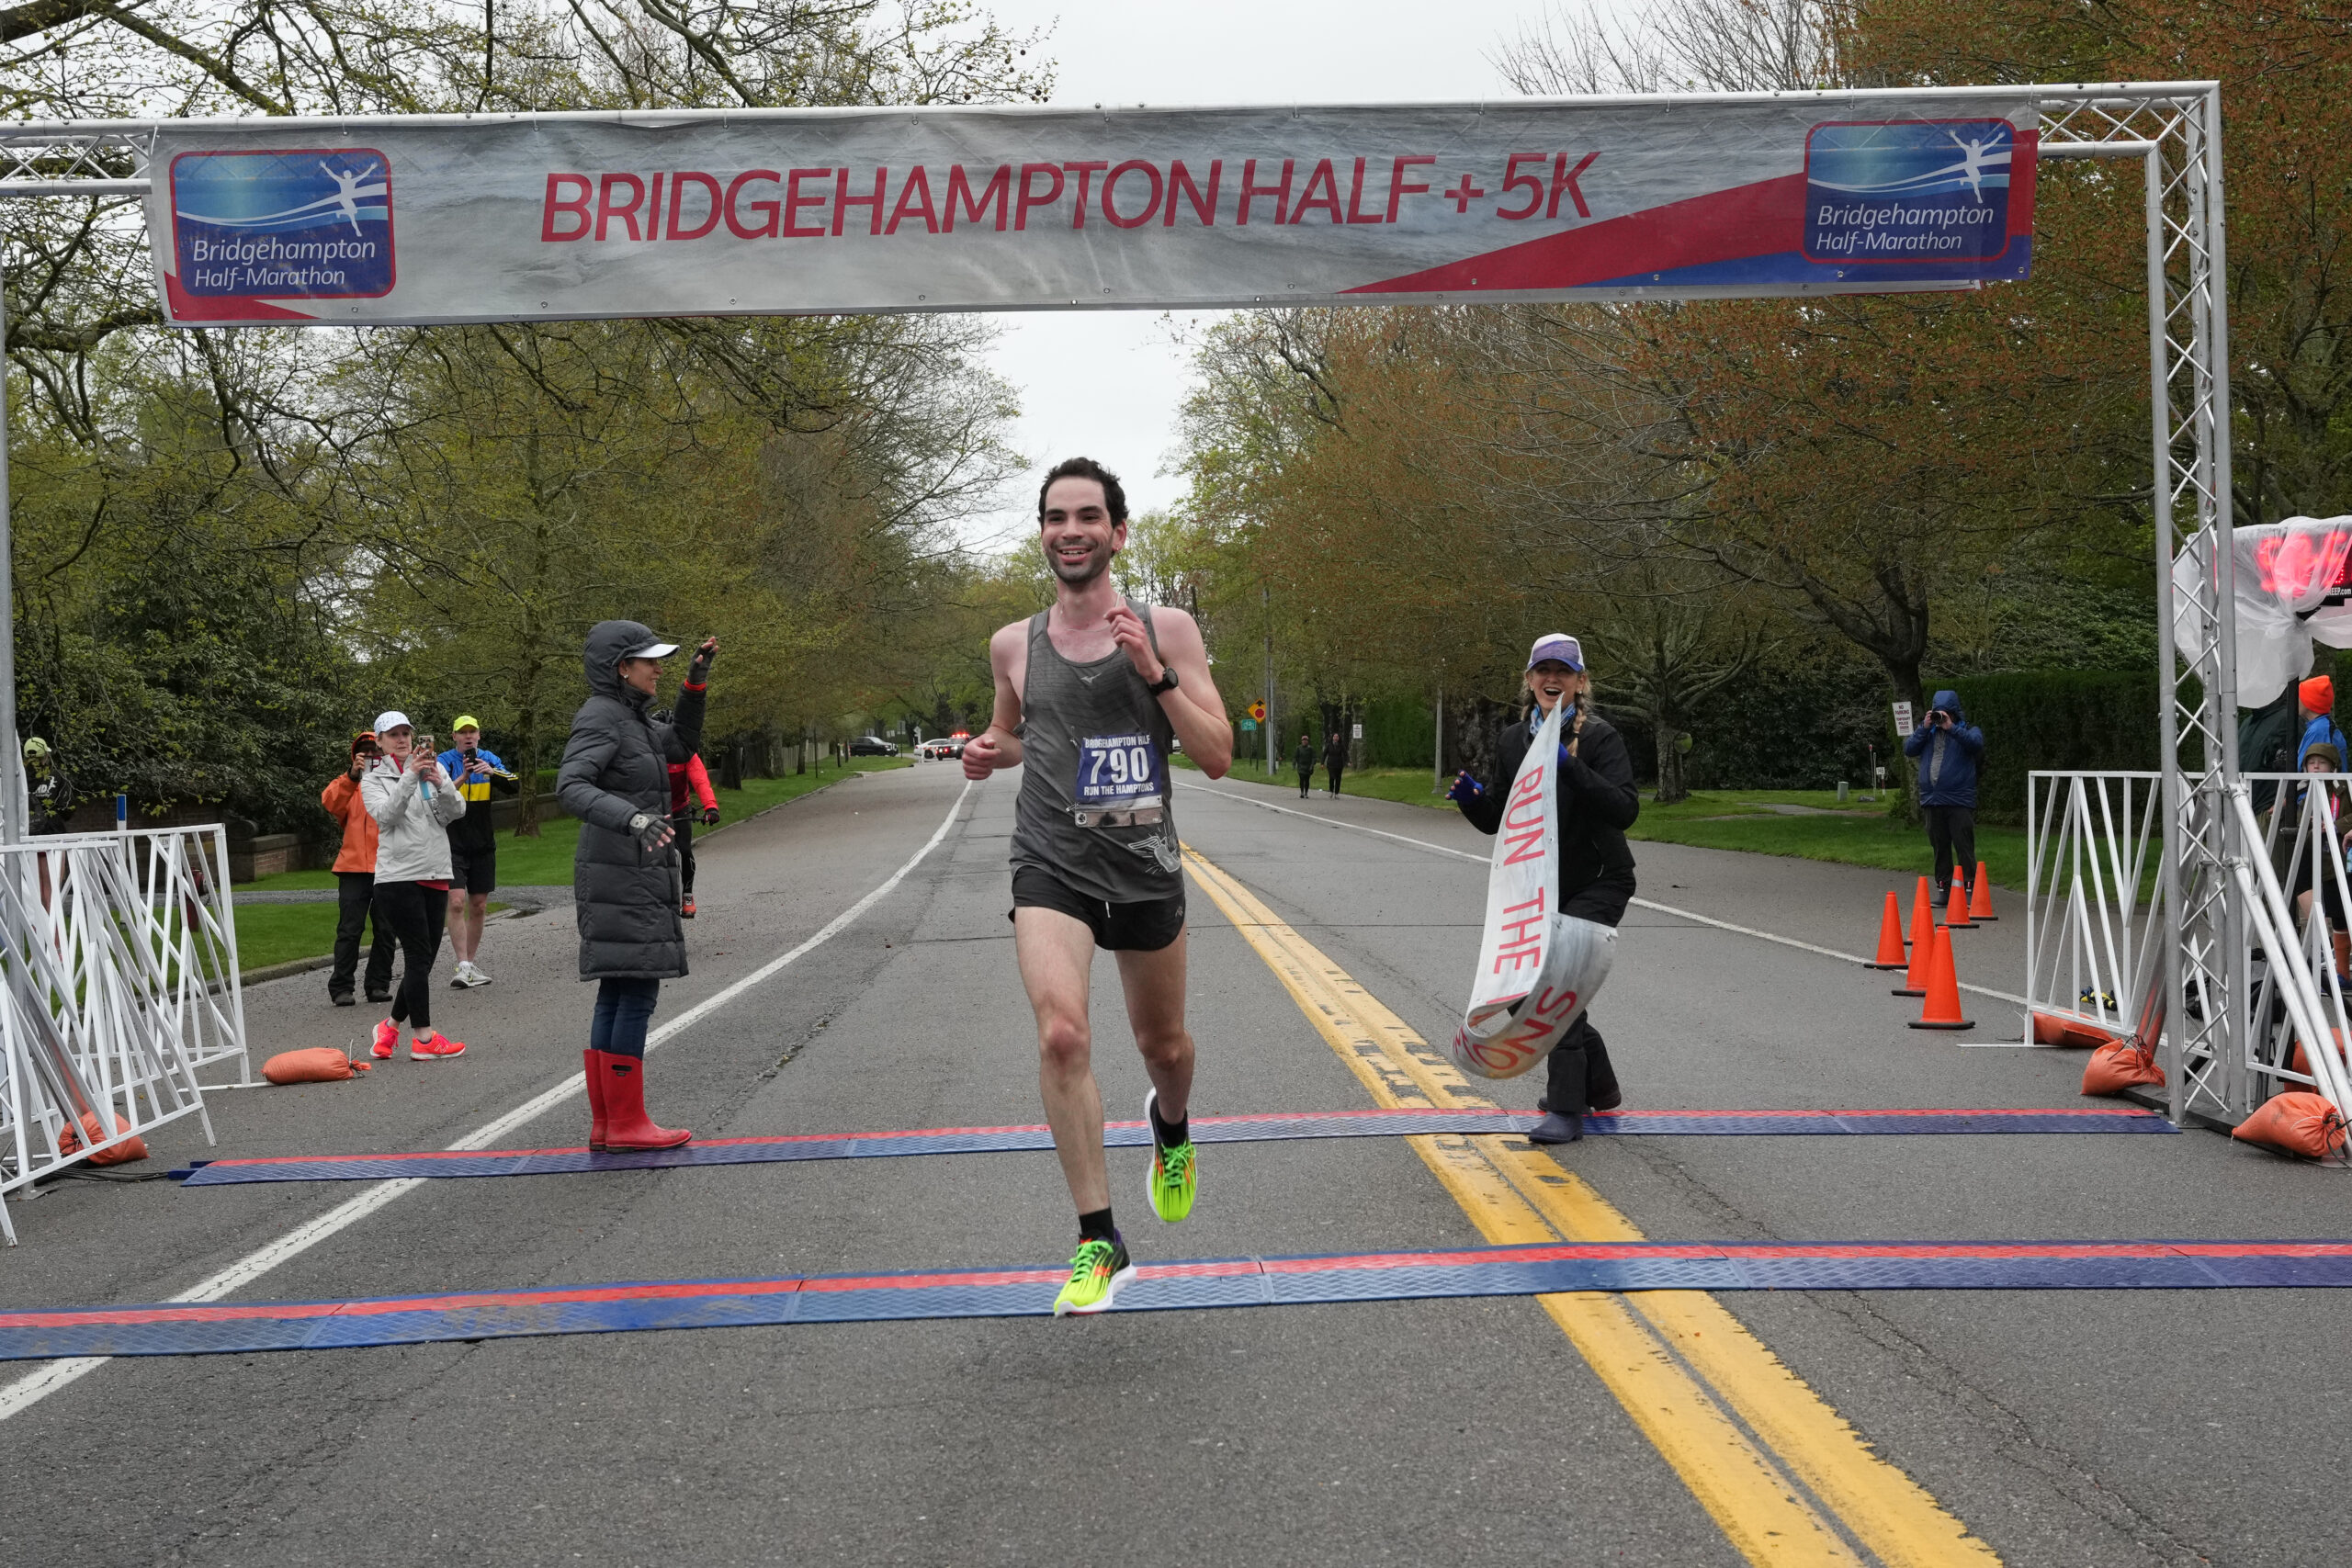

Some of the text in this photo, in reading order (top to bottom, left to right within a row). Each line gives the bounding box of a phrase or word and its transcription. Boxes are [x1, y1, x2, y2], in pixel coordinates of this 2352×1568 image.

[540, 151, 1601, 243] BRIDGEHAMPTON HALF + 5K
[1816, 202, 1994, 231] Bridgehampton
[192, 236, 376, 266] Bridgehampton
[1815, 231, 1962, 254] Half-Marathon
[194, 265, 345, 291] Half-Marathon
[1091, 747, 1149, 784] 790
[1084, 782, 1154, 796] RUN THE HAMPTONS
[1503, 764, 1545, 866] RUN
[1493, 886, 1544, 974] THE
